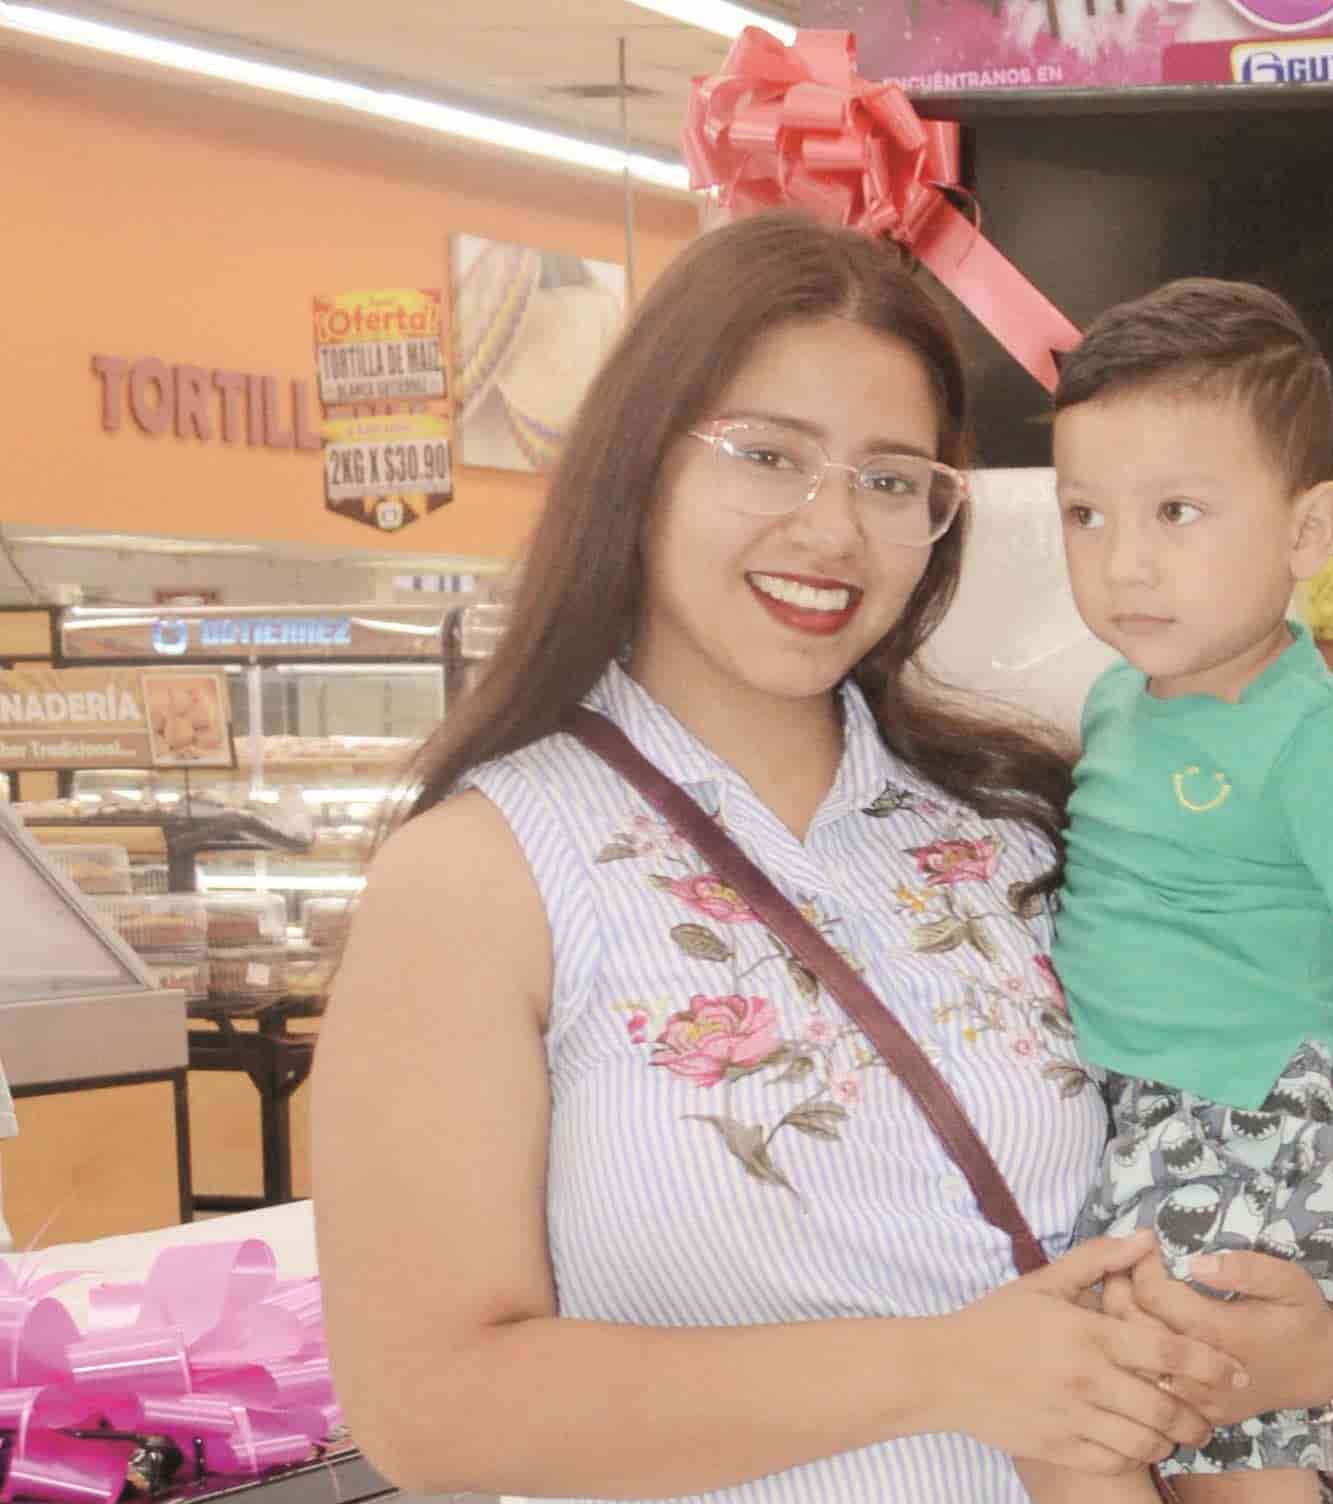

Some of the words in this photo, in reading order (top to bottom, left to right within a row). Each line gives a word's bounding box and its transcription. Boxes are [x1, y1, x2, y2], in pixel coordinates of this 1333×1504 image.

[1037, 65, 1063, 84] EN
[322, 345, 384, 380] TORTILLA
[387, 345, 405, 374] DE
[90, 353, 325, 452] TORTILL
[330, 451, 366, 486] 2KG
[384, 444, 447, 482] $30.90
[0, 683, 142, 721] NADERÍA
